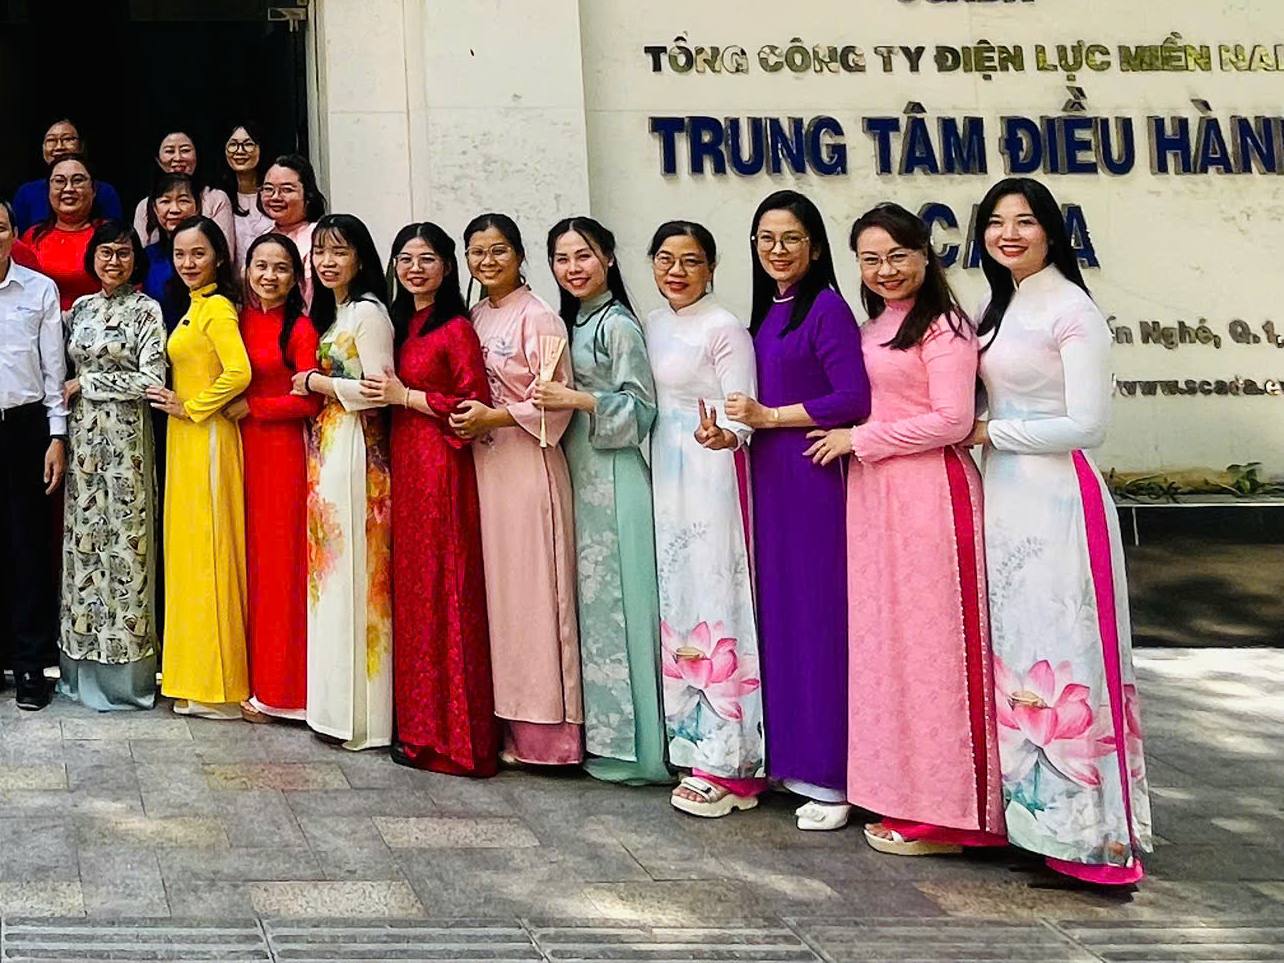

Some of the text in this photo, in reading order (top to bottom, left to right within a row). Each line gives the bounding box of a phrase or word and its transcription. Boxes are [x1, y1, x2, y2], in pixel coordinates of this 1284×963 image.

[644, 30, 749, 73] TỔNG
[758, 37, 866, 73] CÔNG
[874, 45, 925, 72] TY
[934, 39, 1025, 80] ĐIỆN
[1035, 40, 1111, 81] LỰC
[1118, 32, 1211, 72] MIỀN
[649, 86, 1284, 176] TRUNG TÂM ĐIỀU HÀN
